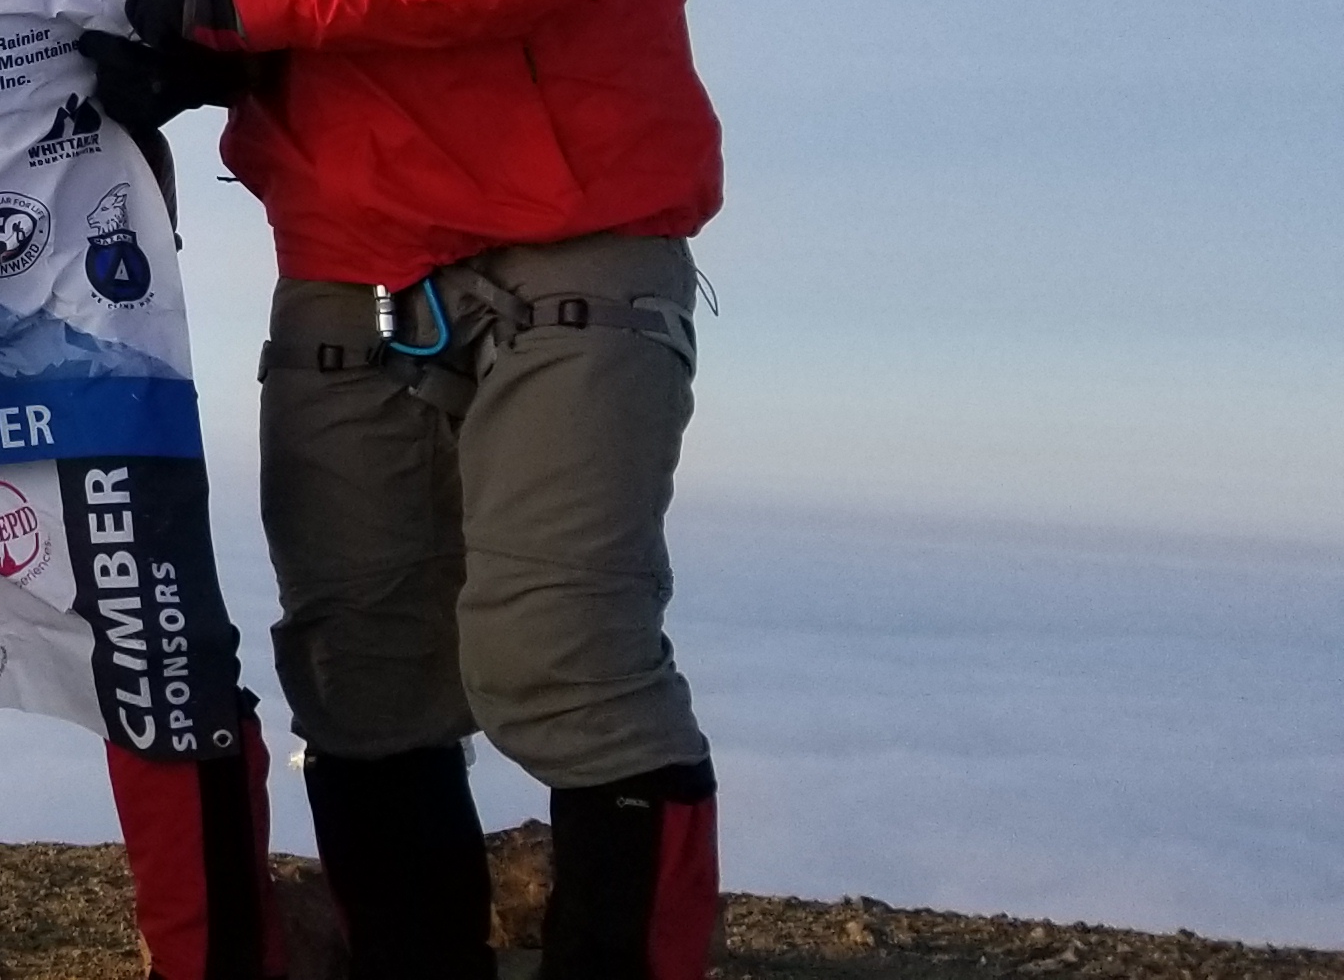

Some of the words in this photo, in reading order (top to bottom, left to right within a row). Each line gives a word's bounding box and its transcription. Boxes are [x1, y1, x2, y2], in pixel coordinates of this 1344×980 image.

[0, 75, 31, 90] Inc.
[84, 466, 156, 750] CLIMBER
[151, 561, 198, 752] SPONSORS
